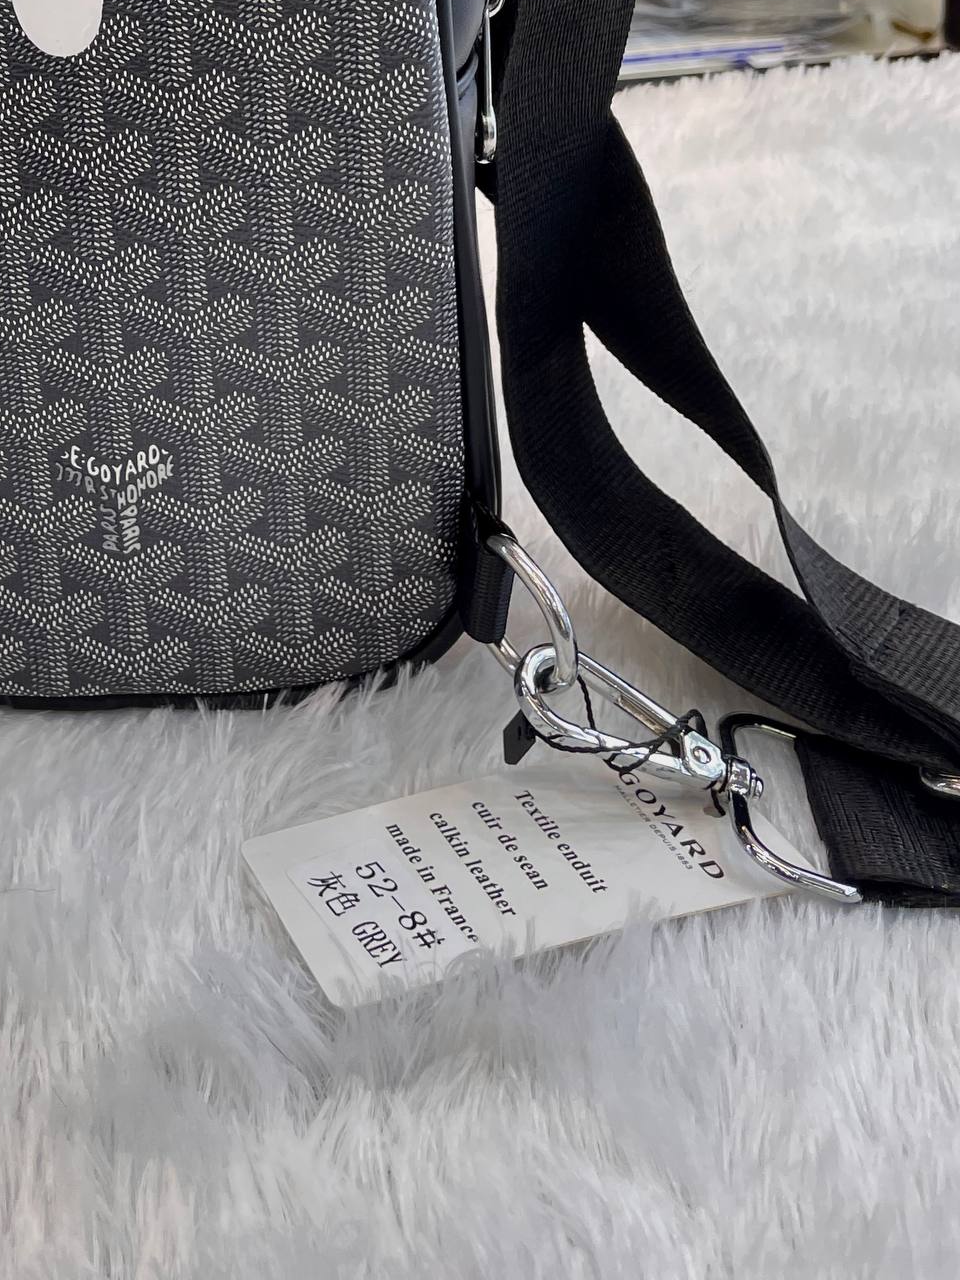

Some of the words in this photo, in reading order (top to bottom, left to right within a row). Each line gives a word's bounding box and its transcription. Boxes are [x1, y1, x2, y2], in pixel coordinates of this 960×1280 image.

[120, 505, 141, 554] PARIS
[429, 812, 471, 858] calkin
[464, 859, 516, 916] leather
[472, 801, 503, 829] cuir
[498, 834, 519, 852] de
[513, 855, 549, 890] sean
[514, 790, 561, 840] Textile
[557, 842, 608, 894] enduit
[619, 772, 725, 879] GOYARD
[649, 823, 677, 852] DEPUIS
[307, 871, 360, 916] 灰色
[351, 921, 407, 968] GREY
[385, 824, 422, 864] made
[416, 865, 436, 883] in
[429, 884, 479, 942] France
